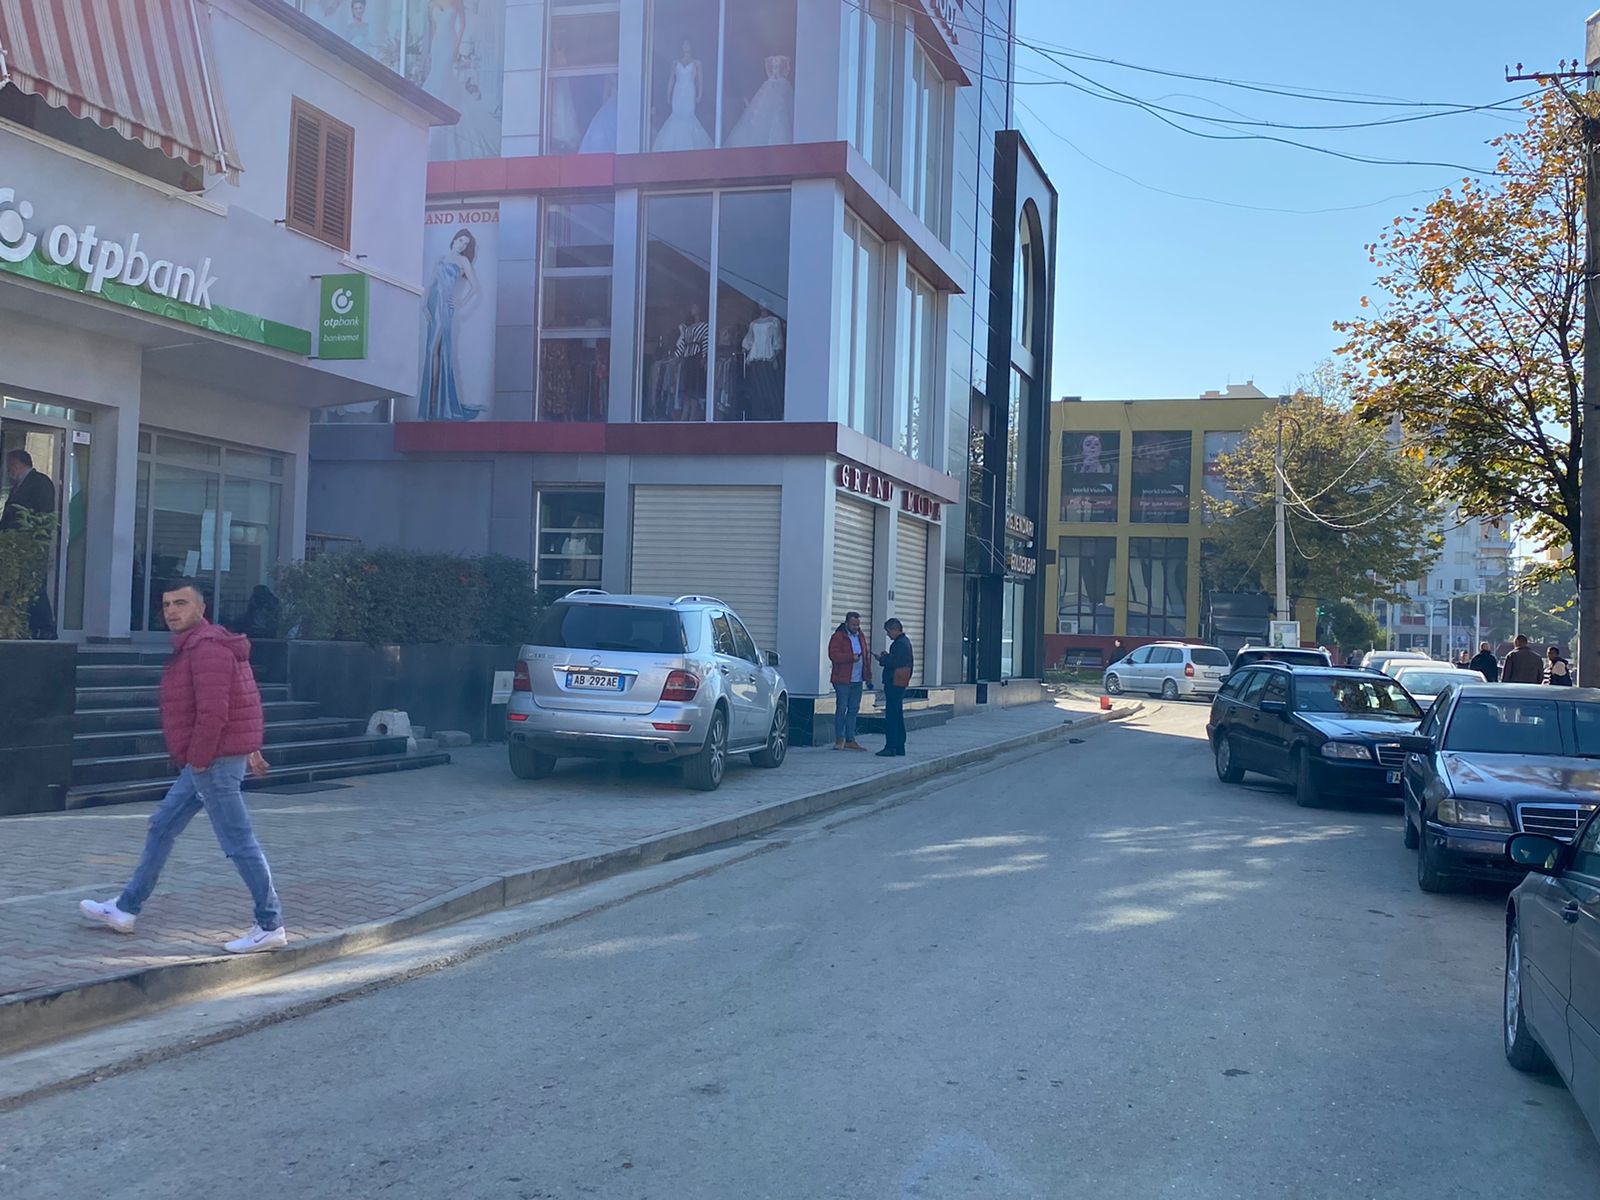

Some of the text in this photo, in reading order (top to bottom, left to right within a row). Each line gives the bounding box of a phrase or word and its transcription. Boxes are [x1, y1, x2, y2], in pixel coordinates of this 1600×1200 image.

[459, 211, 499, 224] MODA
[46, 224, 220, 310] otpbank
[323, 316, 359, 329] otpbank
[574, 675, 585, 685] AB
[589, 676, 606, 687] 292
